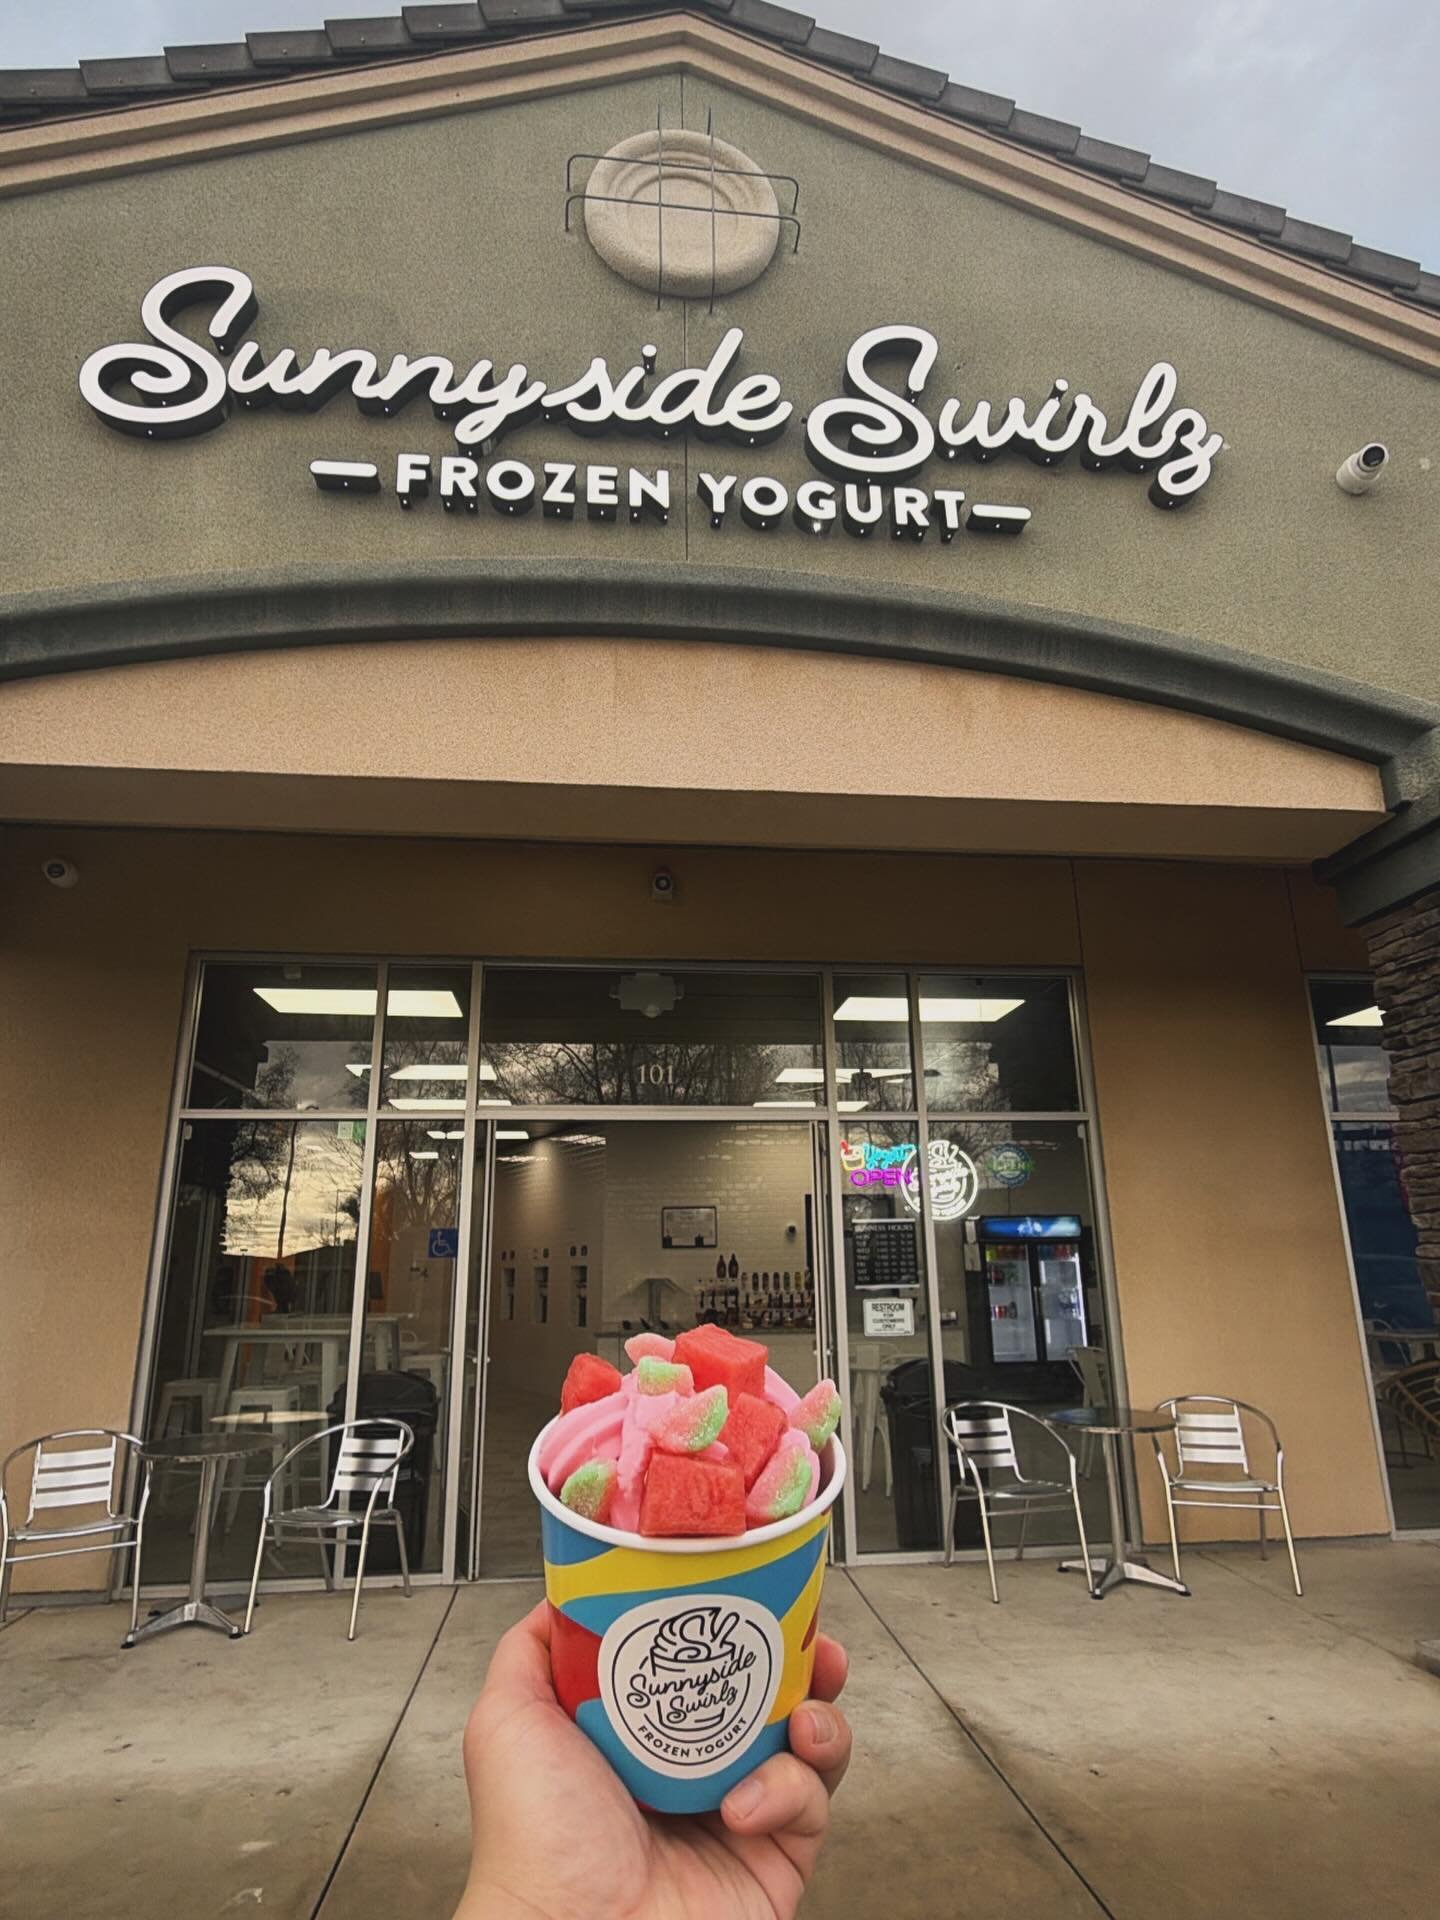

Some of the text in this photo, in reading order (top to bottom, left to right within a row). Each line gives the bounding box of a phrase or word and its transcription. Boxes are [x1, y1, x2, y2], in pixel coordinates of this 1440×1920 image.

[79, 265, 1224, 497] Sunnyside Swirlz
[396, 453, 967, 531] FROZEN YOGURT
[637, 1064, 673, 1084] 101
[850, 1167, 912, 1187] OPEN
[871, 1303, 905, 1312] RESTROOM
[626, 1645, 757, 1709] Sunnyside
[666, 1680, 739, 1724] Swirlz
[637, 1716, 748, 1758] FROZEN YOGURT
